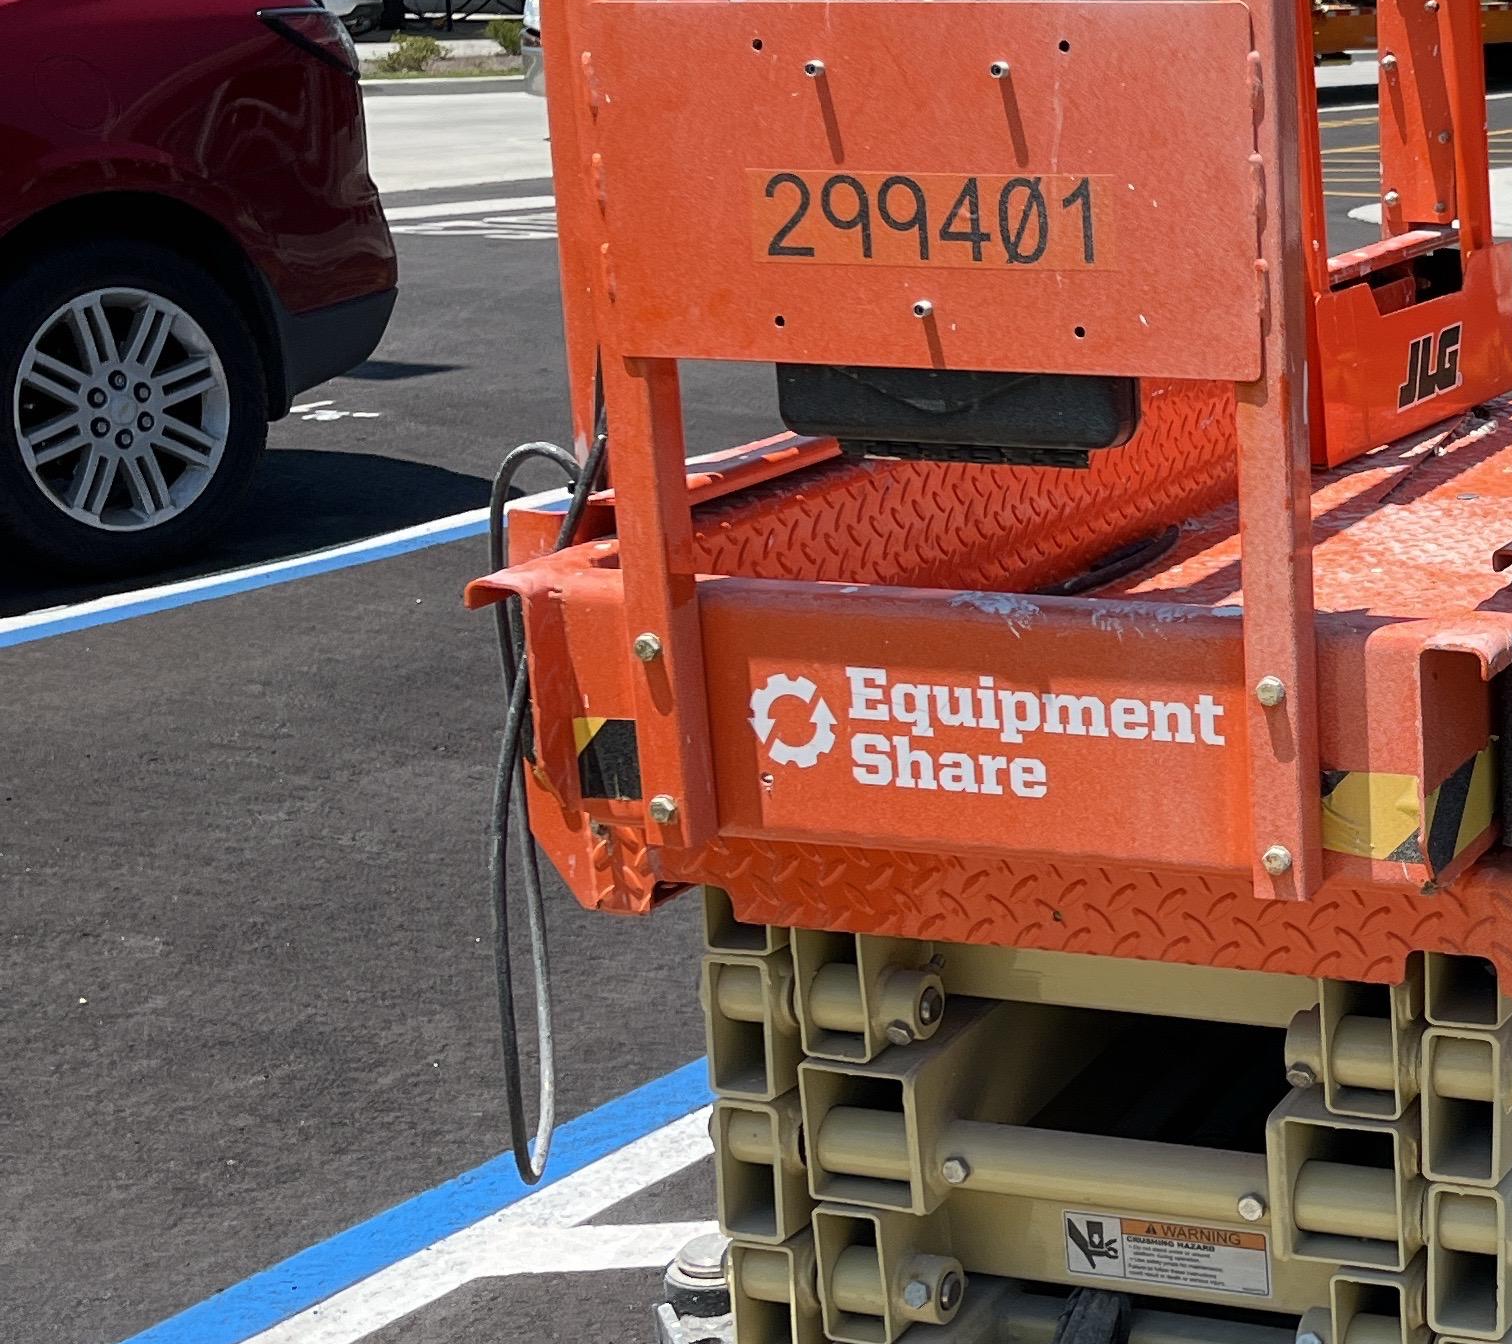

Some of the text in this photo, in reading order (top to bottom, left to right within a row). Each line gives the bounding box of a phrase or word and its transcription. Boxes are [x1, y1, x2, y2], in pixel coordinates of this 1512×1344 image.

[763, 172, 1096, 265] 299401
[1397, 321, 1463, 414] JLG
[845, 666, 1225, 746] Equipment
[851, 732, 1048, 798] Share
[1161, 1224, 1242, 1246] WARNING
[1176, 1241, 1216, 1253] HAZARD
